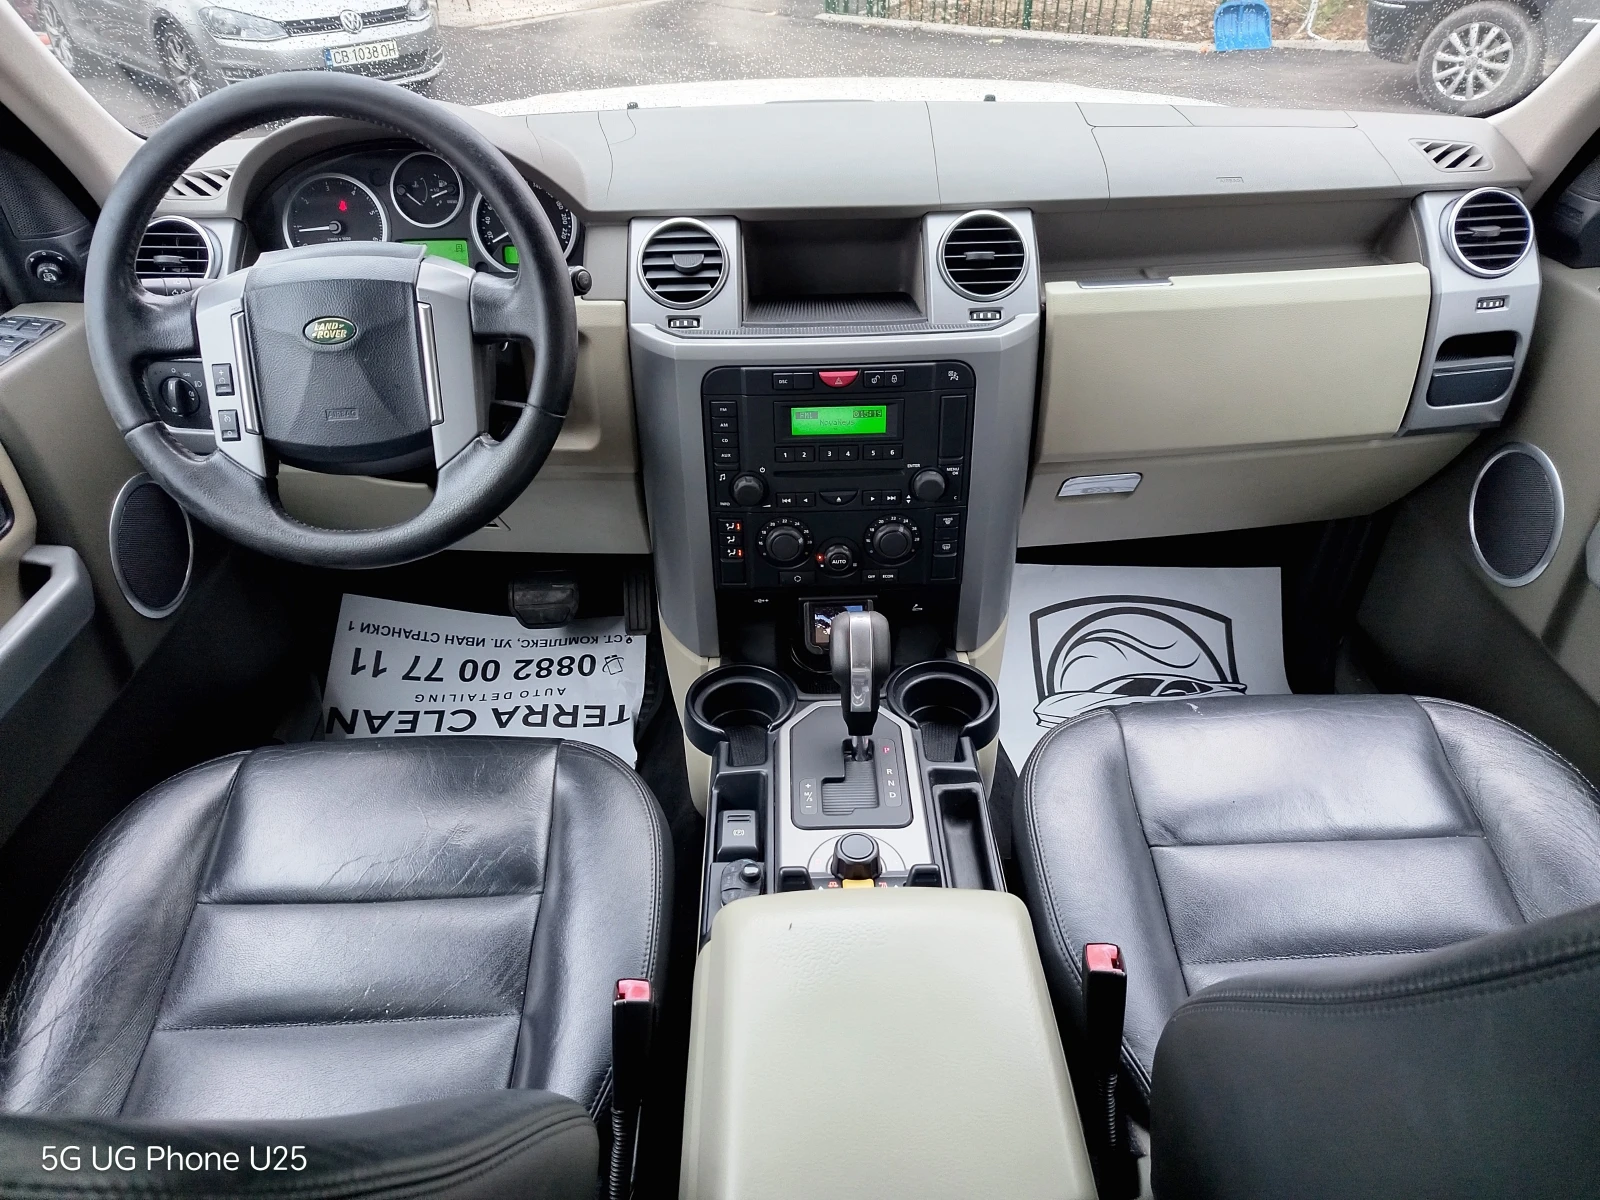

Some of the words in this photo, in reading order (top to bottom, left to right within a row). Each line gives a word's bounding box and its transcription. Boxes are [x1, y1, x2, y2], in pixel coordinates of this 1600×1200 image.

[333, 51, 350, 64] CB
[352, 46, 379, 62] 1038
[380, 41, 396, 57] OH
[484, 216, 491, 225] 40
[314, 321, 339, 331] LAND
[316, 329, 348, 339] ROVER
[347, 620, 354, 632] 1
[359, 622, 441, 643] СТРАНСКИ
[443, 633, 486, 646] ИВАН
[490, 637, 512, 649] УЛ.
[516, 634, 599, 649] КОМПЛЕКС,
[603, 634, 623, 645] СТ.
[350, 647, 388, 678] 11
[401, 655, 444, 682] 77
[513, 653, 597, 681] 0882
[458, 658, 500, 683] 00
[414, 691, 513, 703] DETAILING
[519, 687, 567, 699] AUTO
[325, 706, 478, 735] CLEAN
[491, 703, 631, 730] TERRA
